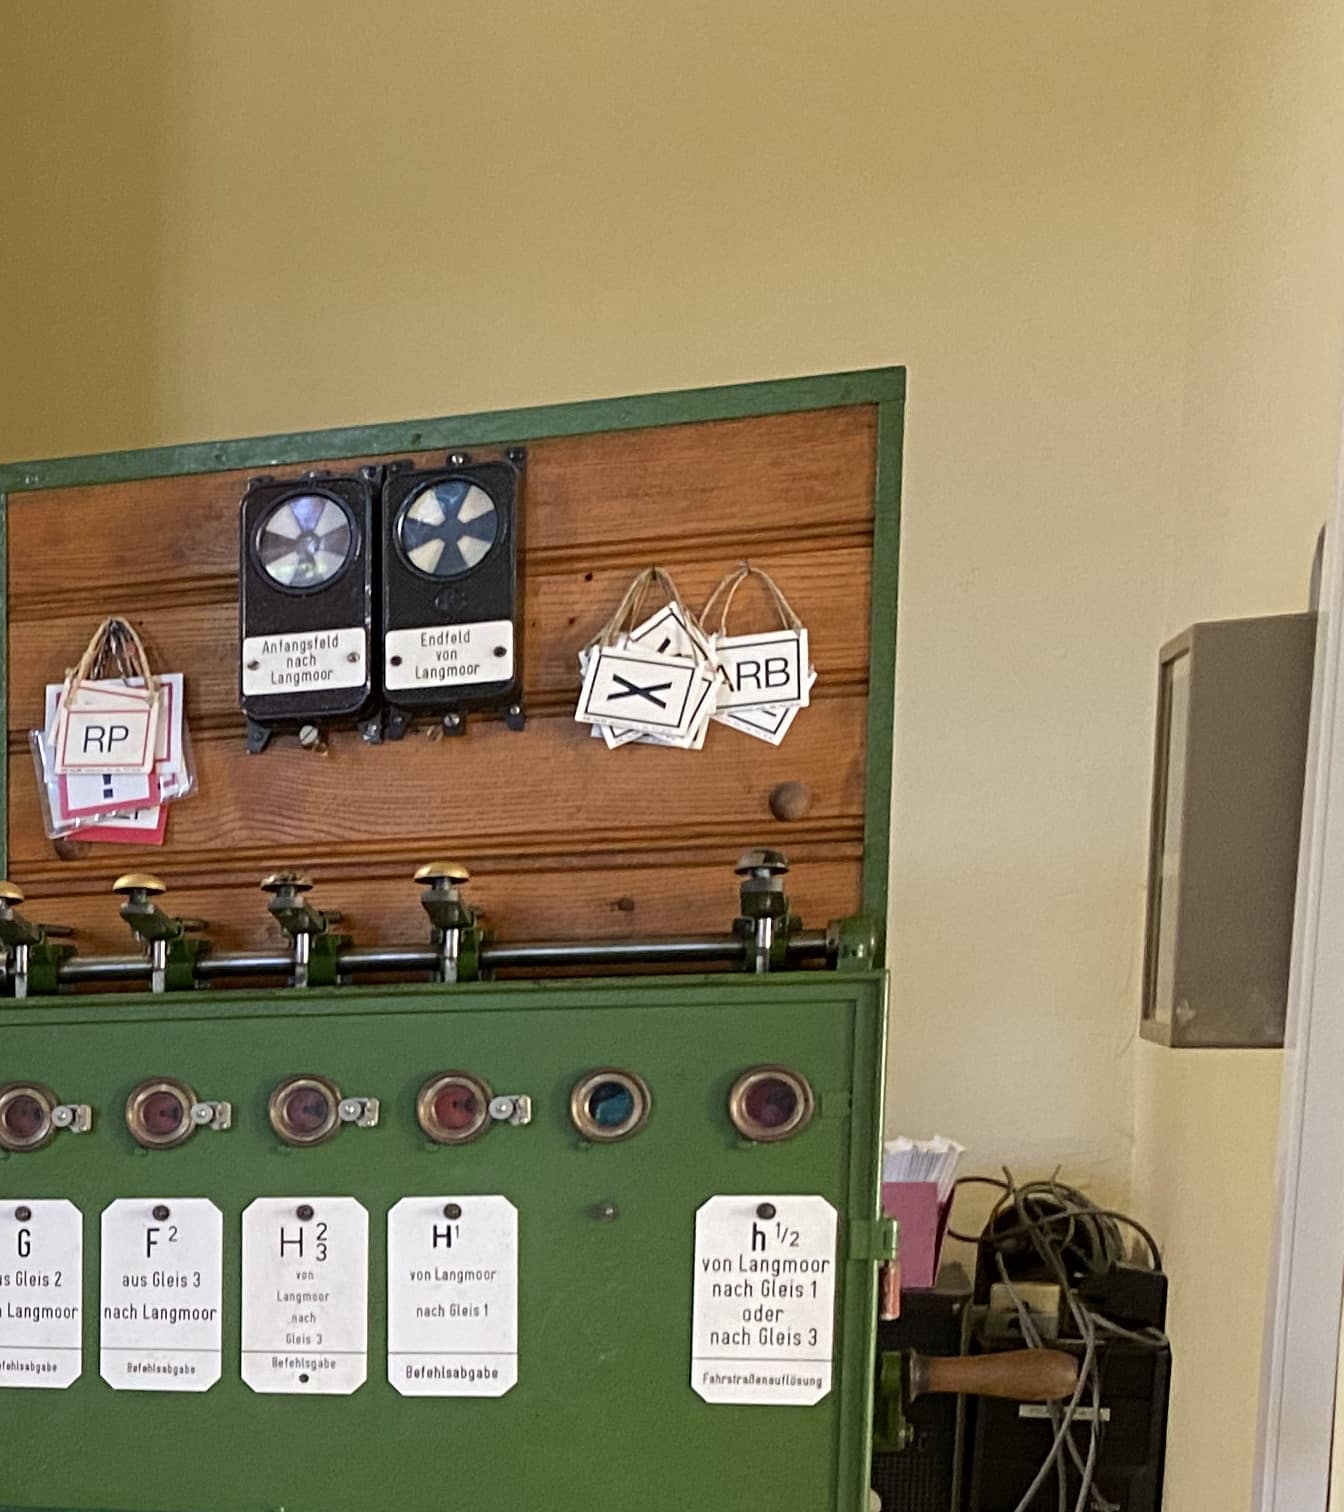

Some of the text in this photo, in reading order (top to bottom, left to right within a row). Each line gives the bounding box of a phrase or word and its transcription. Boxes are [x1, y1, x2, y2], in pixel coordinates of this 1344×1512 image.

[262, 632, 339, 655] Anfangsfeld
[420, 629, 471, 648] Endfeld
[285, 653, 317, 668] nach
[436, 649, 458, 662] von
[270, 669, 334, 687] Langmoor
[415, 663, 481, 681] Langmoor
[83, 725, 130, 753] RP
[17, 1228, 31, 1258] G
[702, 1253, 830, 1278] von Langmoor
[15, 1269, 50, 1287] Gleis
[54, 1270, 62, 1288] 2
[122, 1270, 201, 1289] aus Gleis 3
[295, 1271, 314, 1281] von
[409, 1267, 497, 1284] von Langmoor
[276, 1289, 330, 1305] Langmoor
[712, 1278, 817, 1299] nach Gleis 1
[7, 1302, 79, 1323] Langmoor
[104, 1303, 217, 1325] nach Langmoor
[291, 1312, 317, 1324] nach
[416, 1303, 489, 1318] nach Gleis 1
[742, 1303, 785, 1323] oder
[285, 1332, 323, 1345] Gleis 3
[710, 1326, 818, 1347] nach Gleis 3
[126, 1361, 196, 1377] Befehlsabgabe
[271, 1356, 337, 1372] Befehlsgabe
[405, 1364, 499, 1382] Befehlsabgabe
[702, 1371, 823, 1390] Fahrstraßenauflösung
